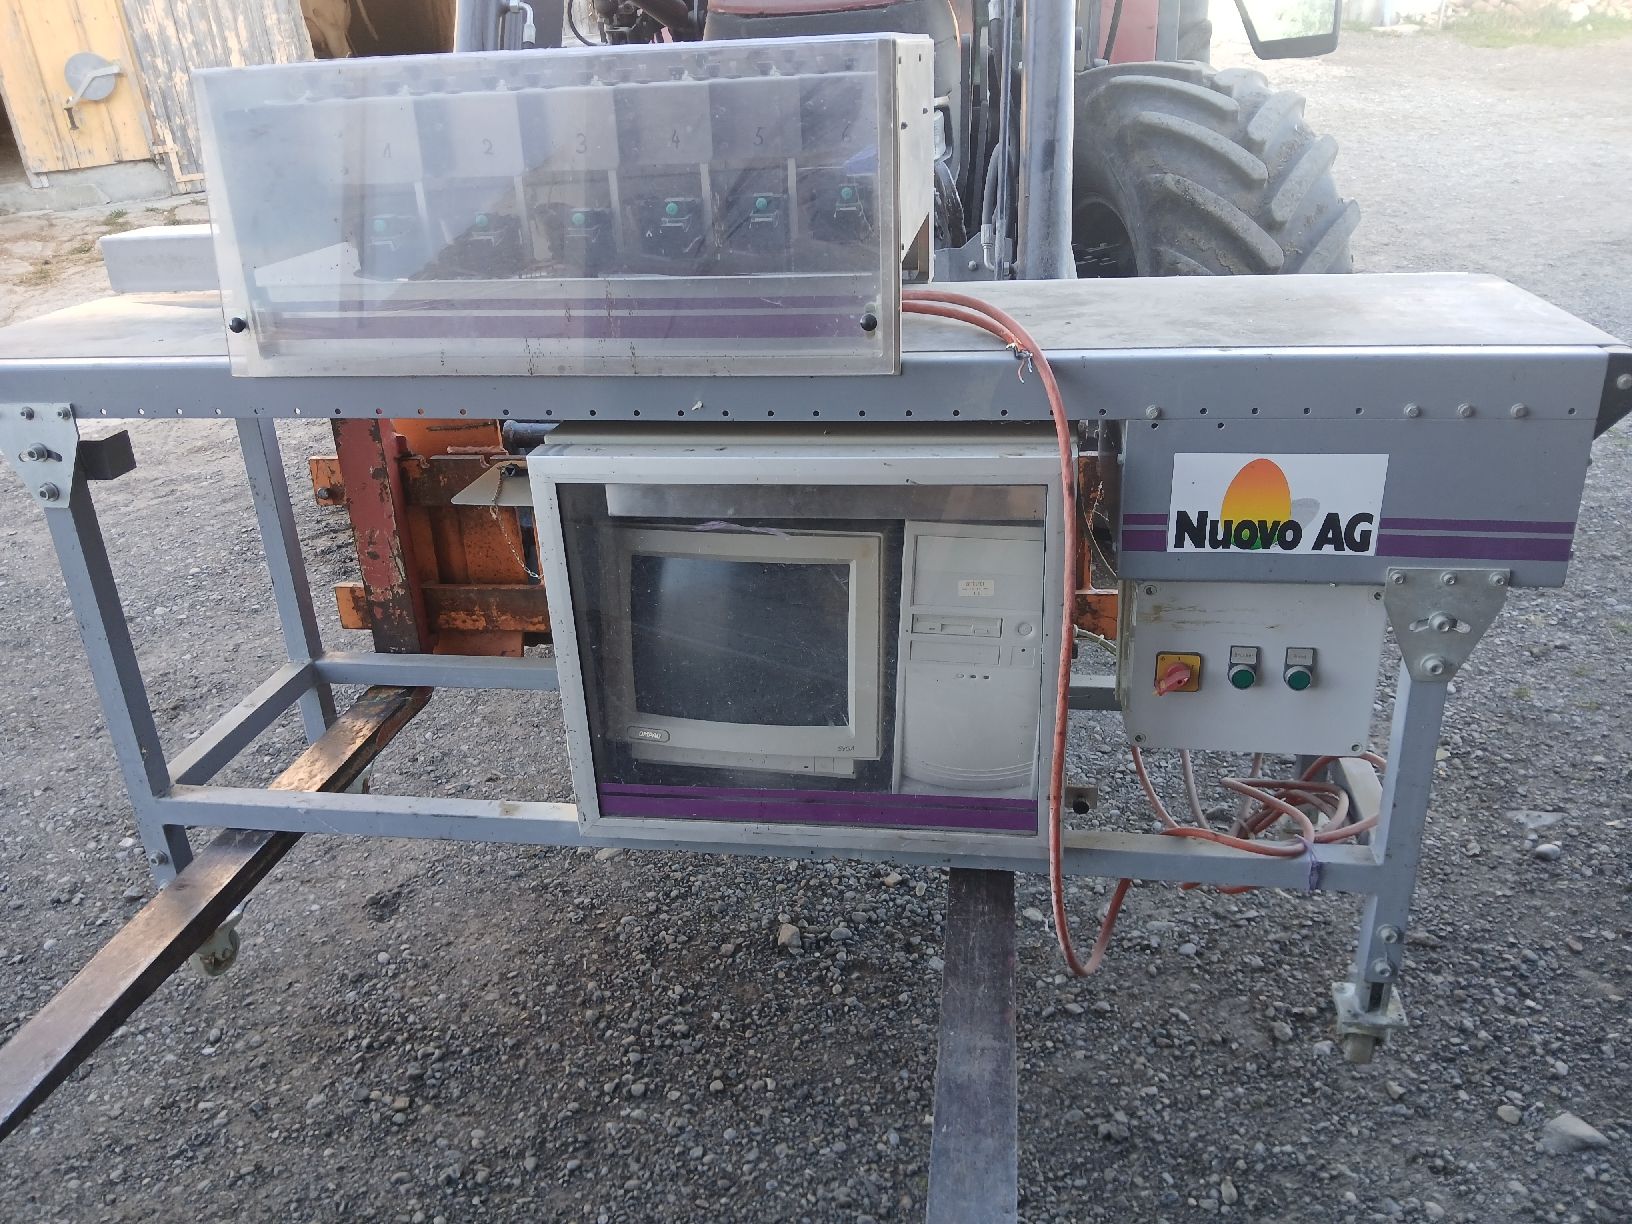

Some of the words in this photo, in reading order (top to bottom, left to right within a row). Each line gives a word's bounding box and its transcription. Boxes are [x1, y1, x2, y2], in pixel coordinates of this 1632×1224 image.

[575, 132, 587, 154] 3
[671, 128, 681, 149] 4
[753, 126, 764, 145] 5
[482, 138, 494, 155] 2
[1311, 512, 1374, 552] AG
